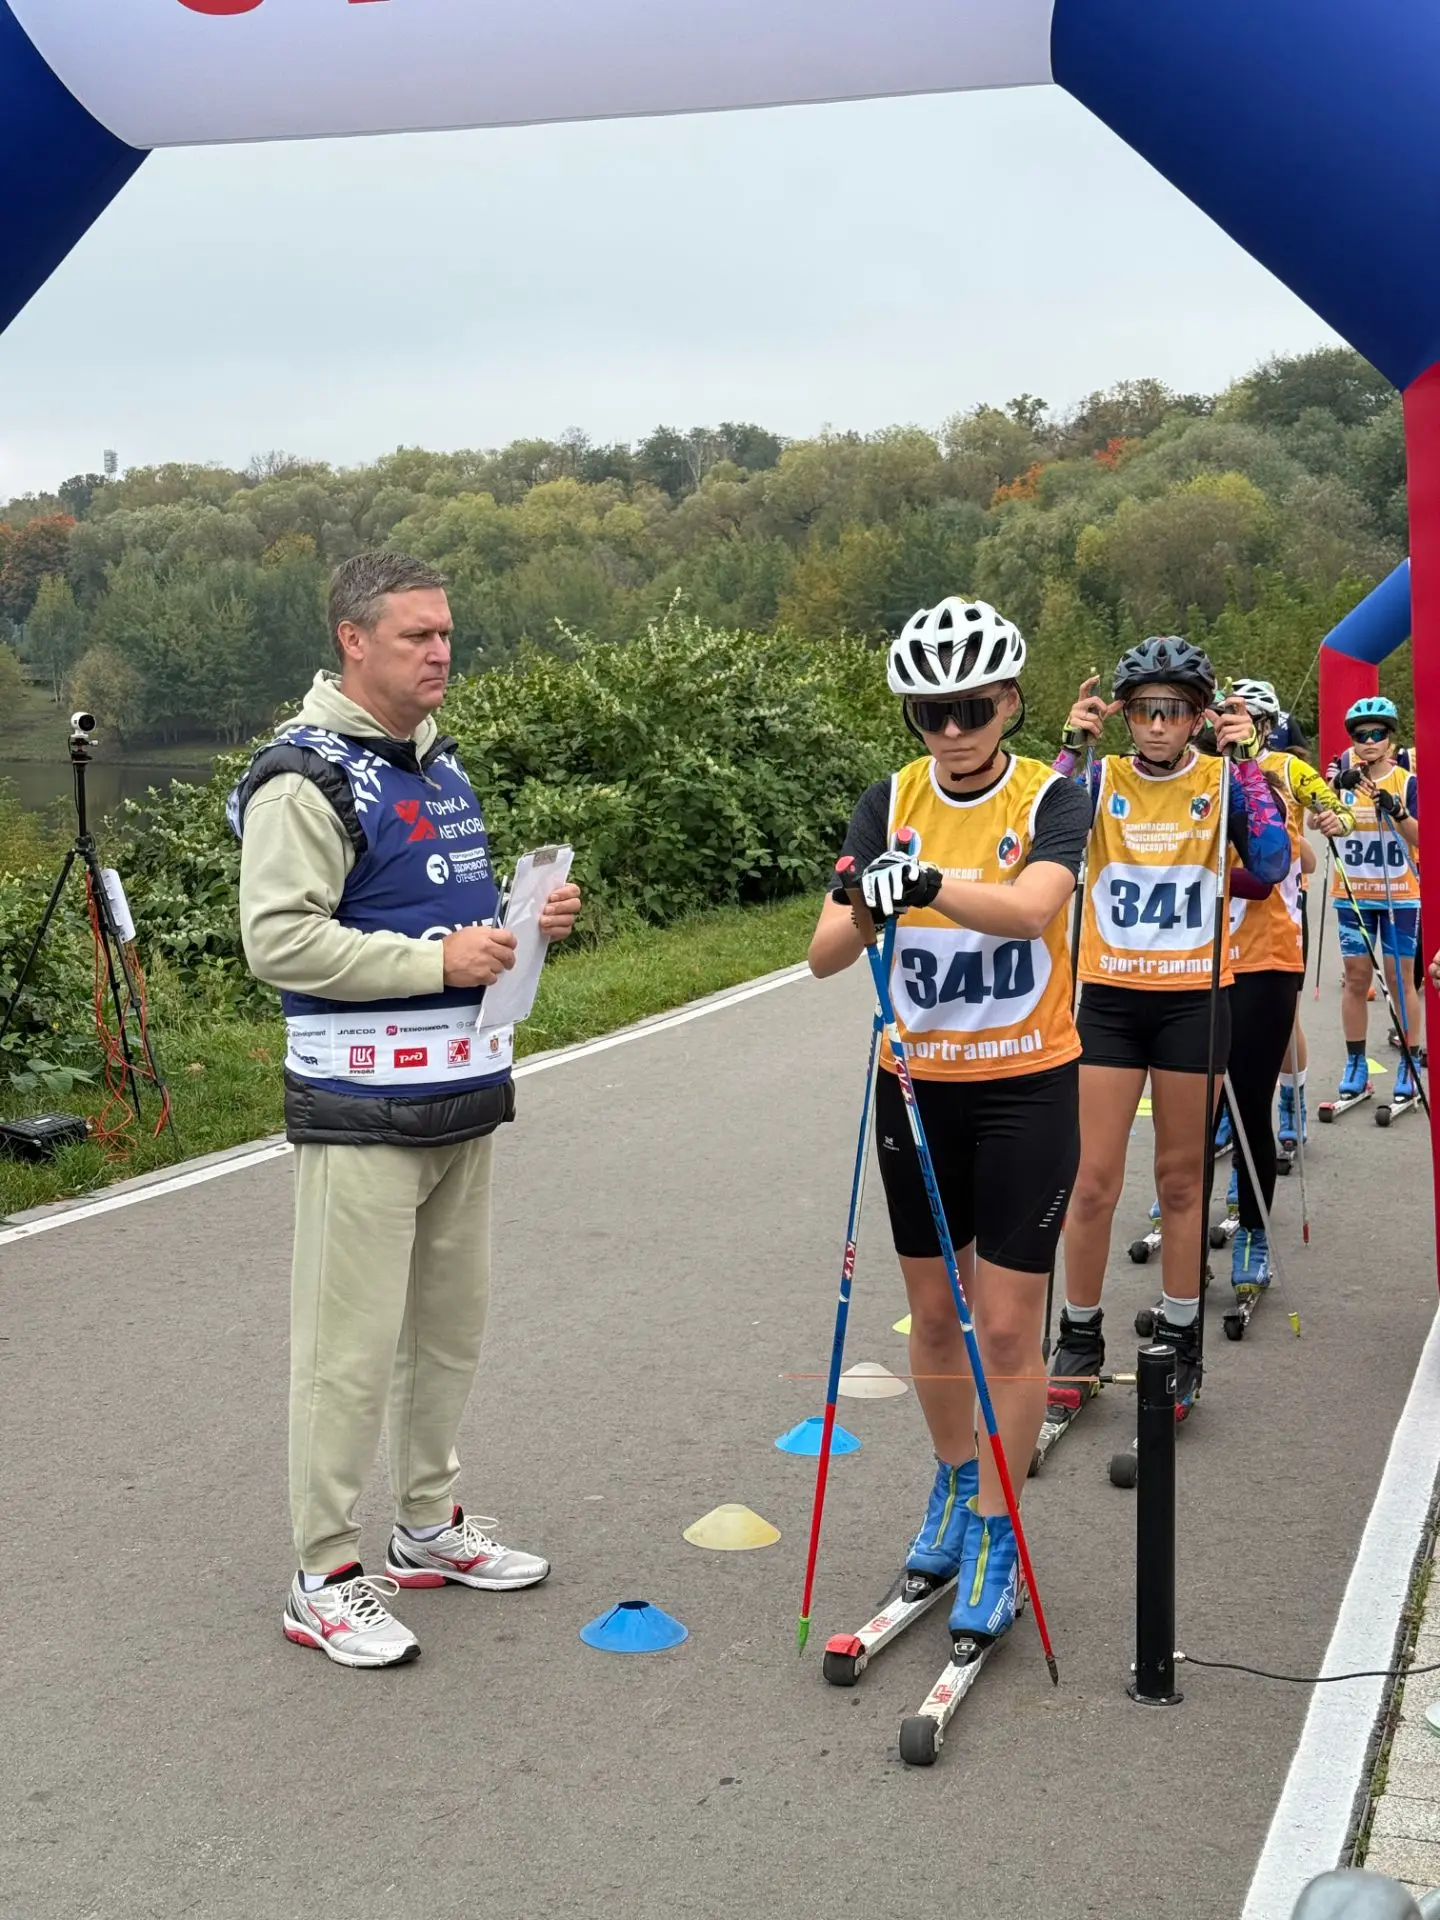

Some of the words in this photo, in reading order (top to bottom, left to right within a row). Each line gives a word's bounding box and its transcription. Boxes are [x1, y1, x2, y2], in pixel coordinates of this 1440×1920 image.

[425, 795, 470, 816] ГОНКА
[1345, 839, 1405, 867] 346
[455, 869, 489, 884] ОТЕЧЕСТВА
[1110, 879, 1202, 929] 341
[902, 940, 1035, 1009] 340
[1099, 954, 1213, 975] sportrammo
[904, 1028, 1042, 1061] portrammol
